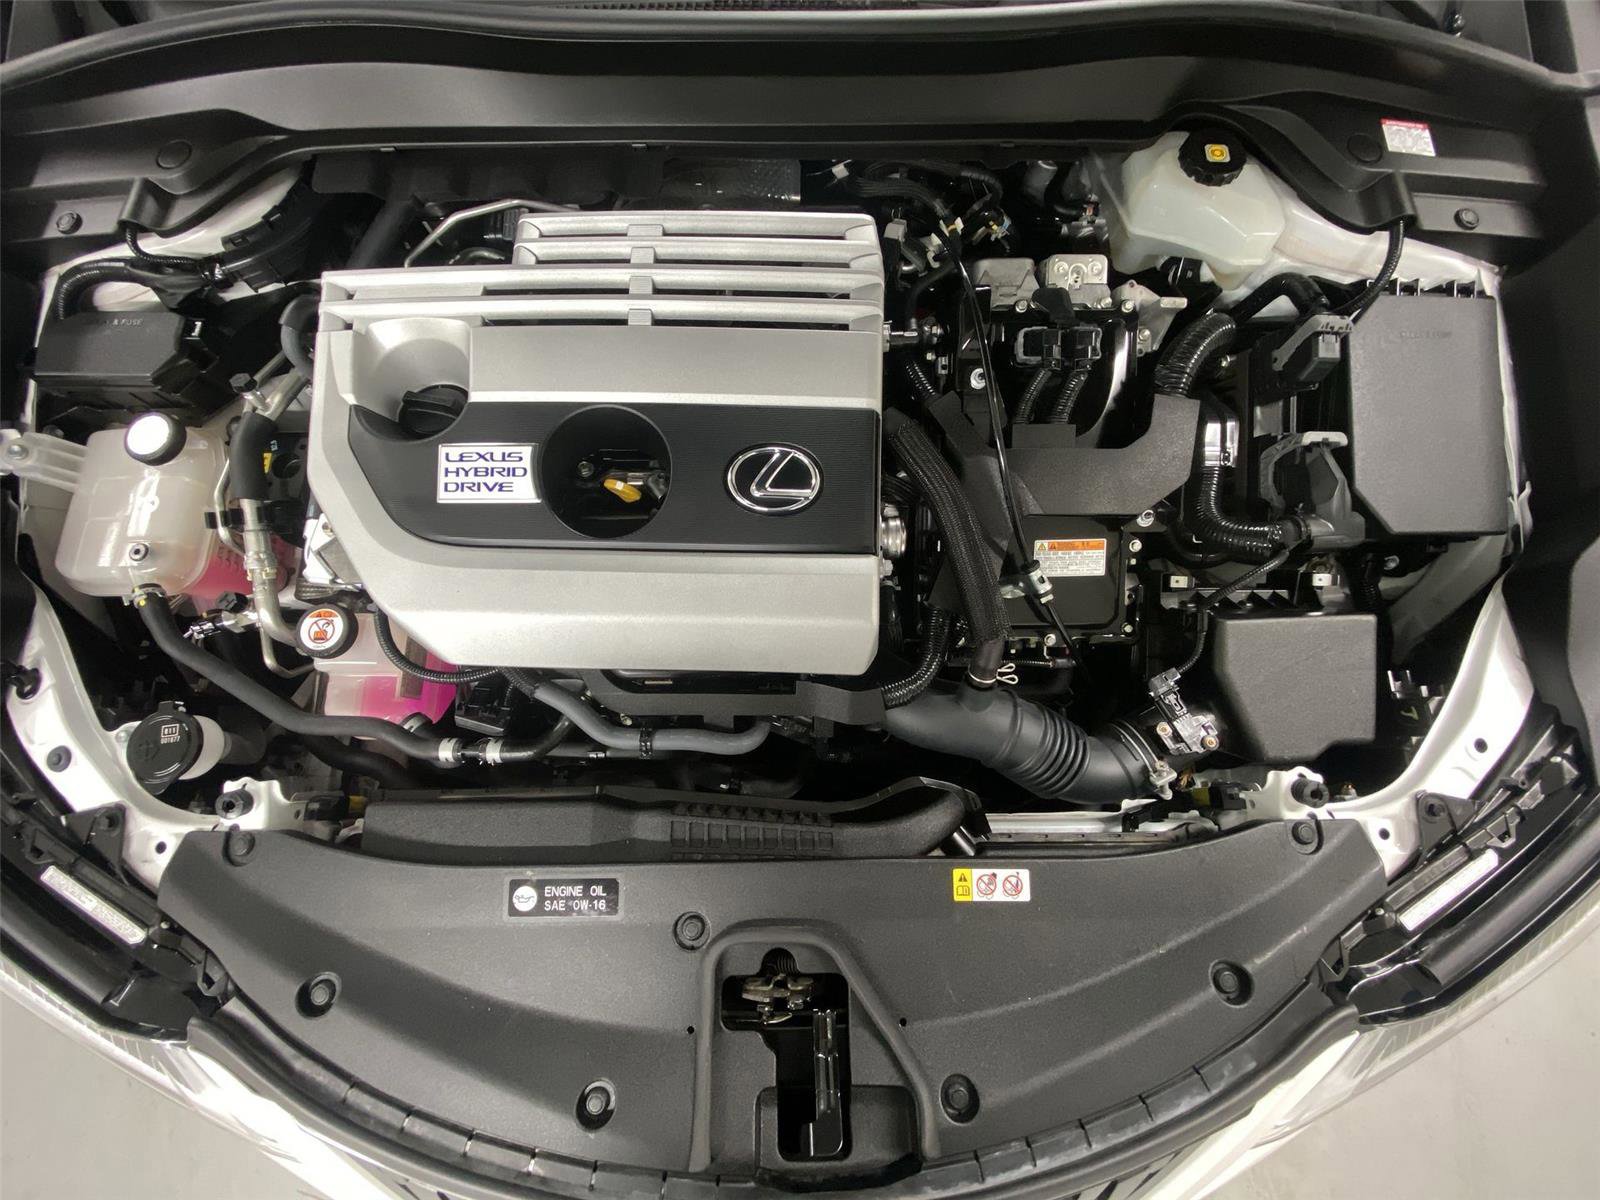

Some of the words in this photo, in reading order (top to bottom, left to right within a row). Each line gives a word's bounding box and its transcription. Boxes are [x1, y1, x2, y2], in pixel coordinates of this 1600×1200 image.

[445, 451, 523, 463] LEXUS
[444, 466, 528, 478] HYBRID
[443, 481, 514, 493] DRIVE
[544, 885, 583, 897] ENGINE
[589, 885, 607, 897] OIL
[544, 900, 566, 911] SAE
[572, 899, 607, 911] 0W-16
